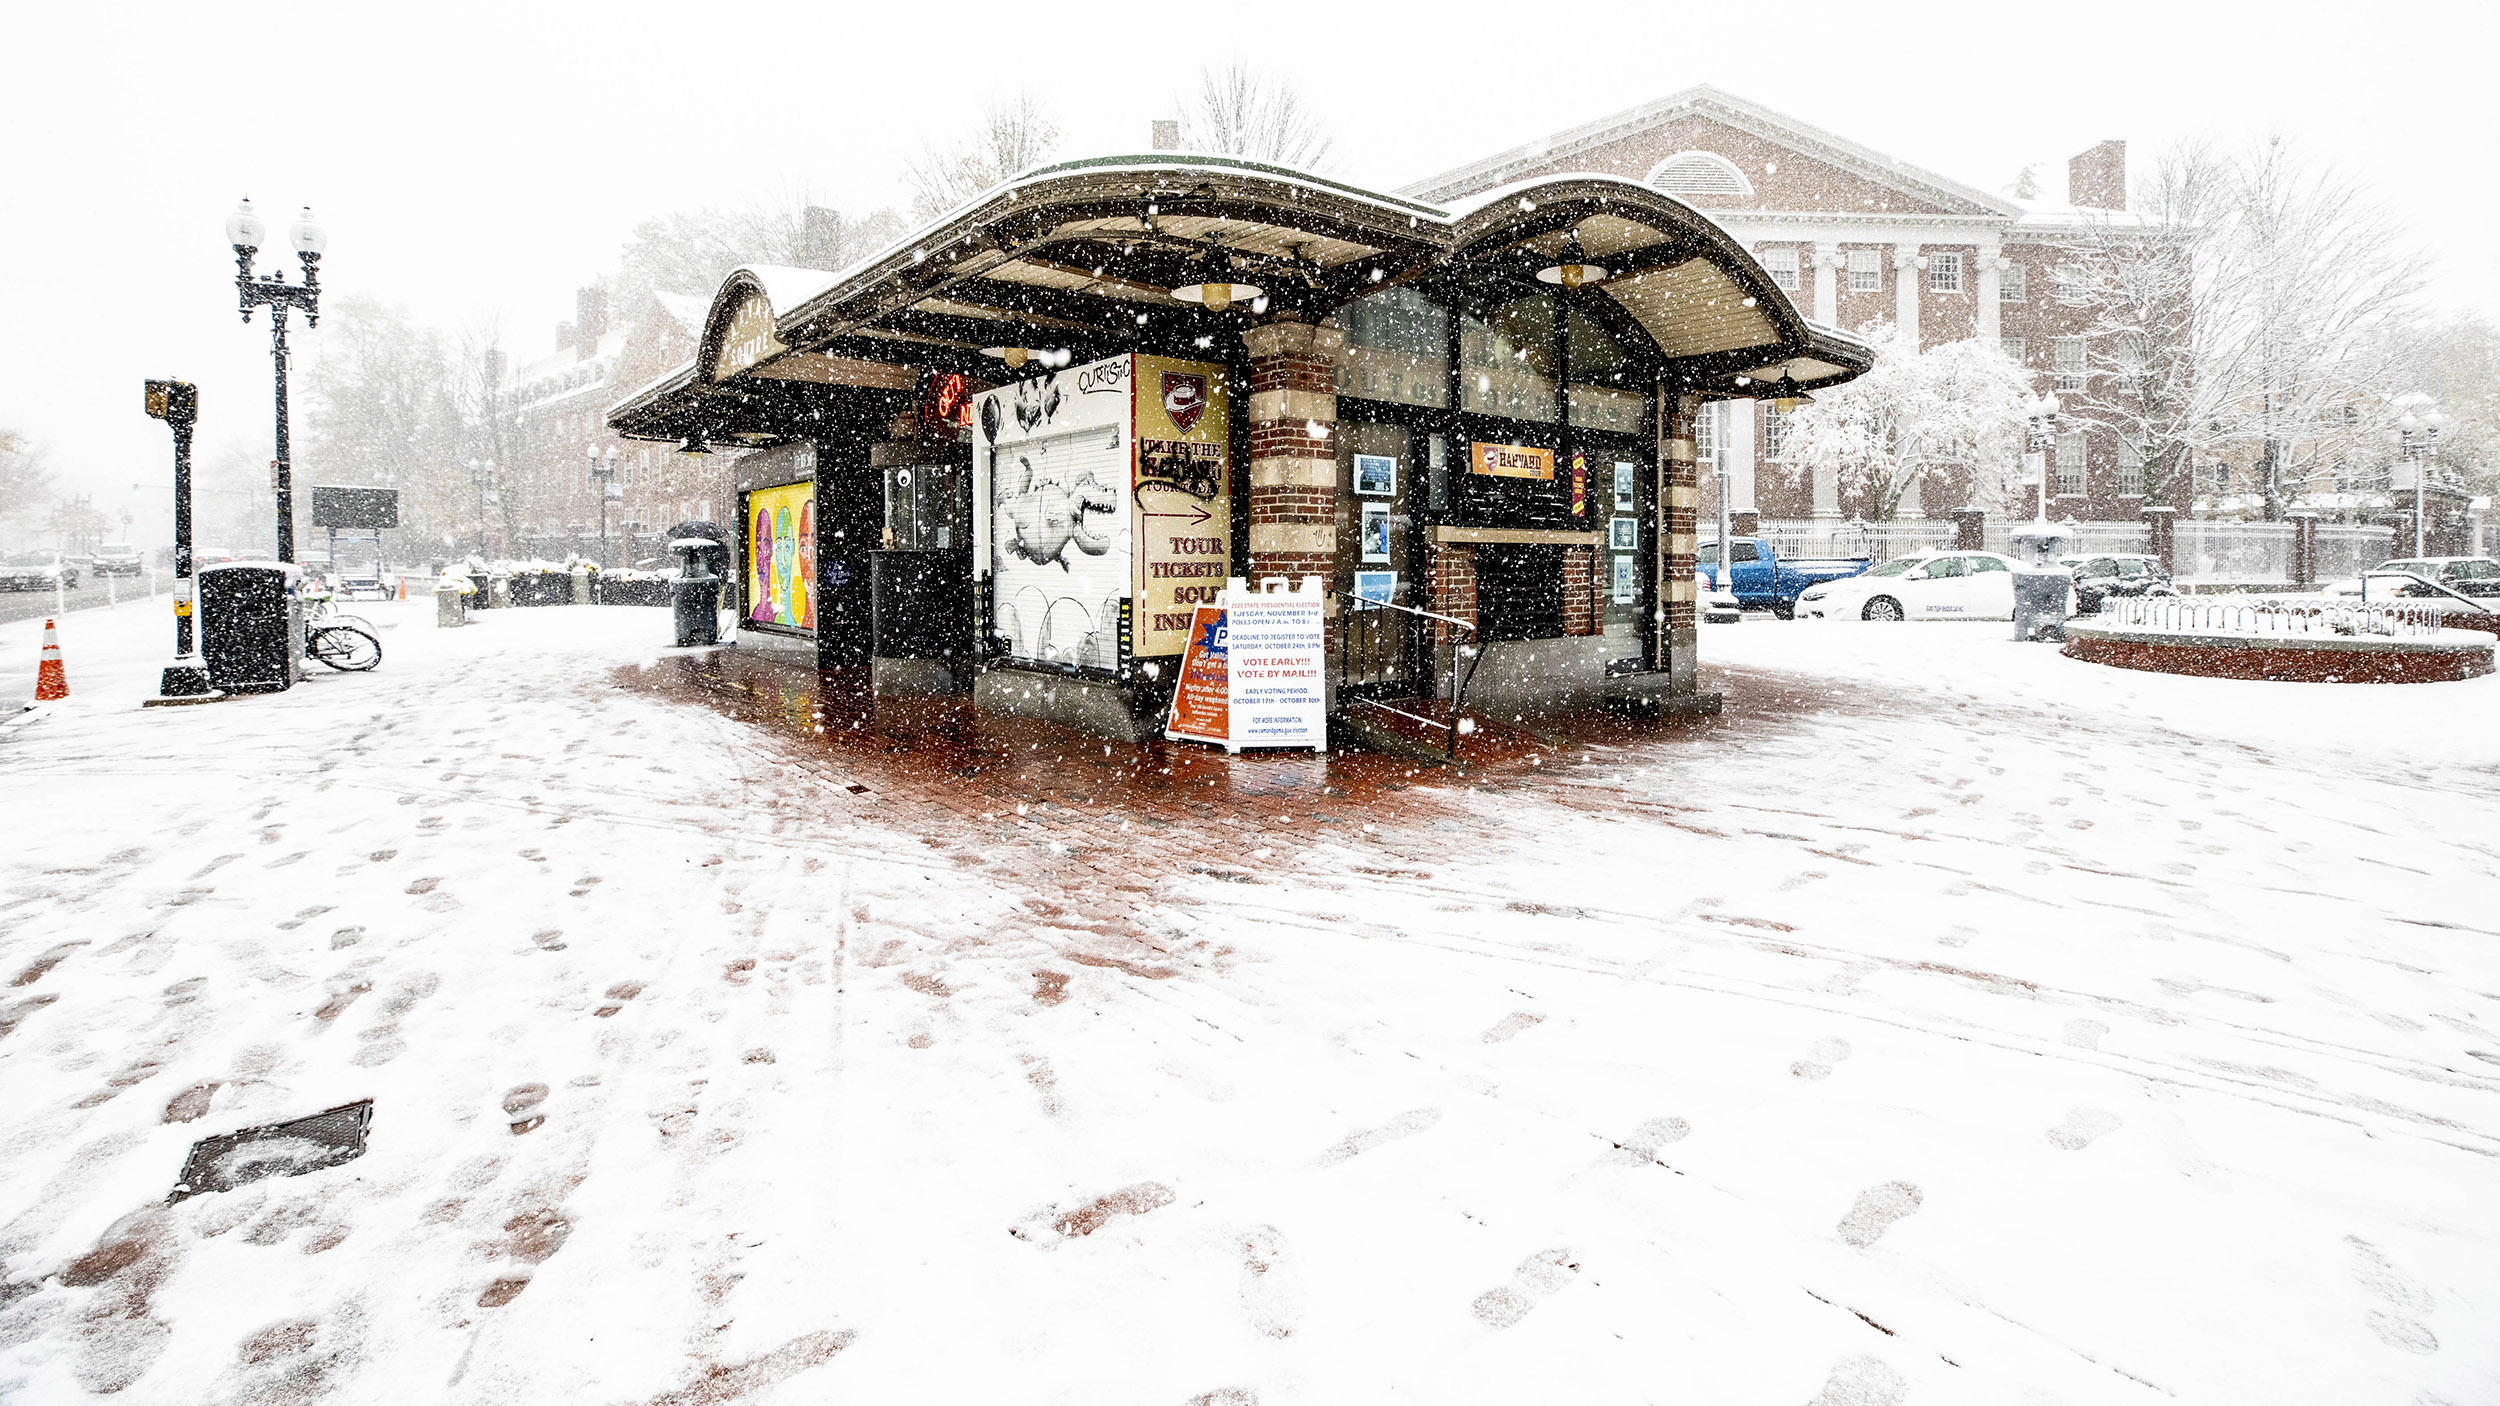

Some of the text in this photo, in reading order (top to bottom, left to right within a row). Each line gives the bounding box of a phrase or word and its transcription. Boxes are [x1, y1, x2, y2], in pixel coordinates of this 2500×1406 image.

[1191, 442, 1221, 457] THE
[1499, 453, 1541, 470] HARVARD
[1146, 482, 1179, 493] TOUR
[1169, 537, 1225, 555] TOUR
[1150, 562, 1225, 578] TICKETS
[1243, 658, 1310, 666] VOTE EARLY!!!
[1237, 670, 1265, 678] VOTE
[1267, 670, 1280, 678] BY
